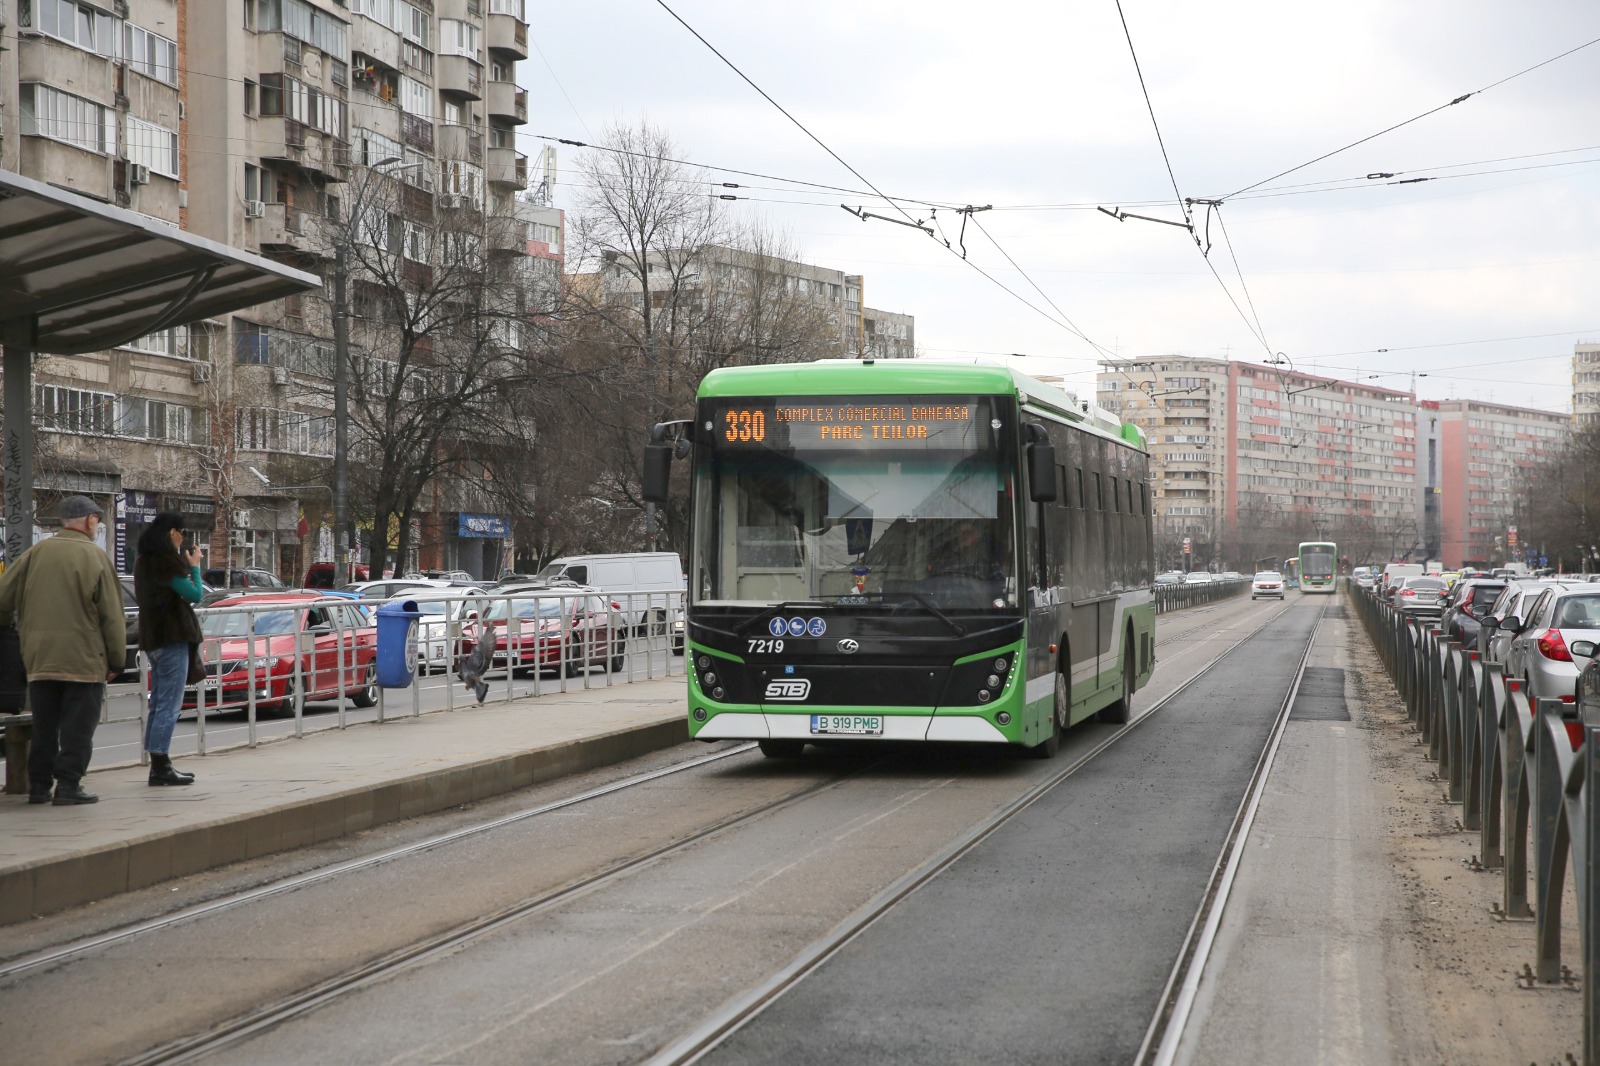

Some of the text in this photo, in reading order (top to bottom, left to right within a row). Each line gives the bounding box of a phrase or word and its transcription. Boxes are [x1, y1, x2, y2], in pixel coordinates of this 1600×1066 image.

[776, 407, 833, 422] COMPLEX
[838, 407, 907, 421] COMERCIAL
[725, 410, 765, 442] 330
[820, 425, 928, 440] PARC TEILOR
[748, 640, 784, 653] 7219
[765, 682, 807, 697] STB
[820, 717, 828, 728] B
[832, 717, 852, 729] 919
[853, 717, 879, 729] PMB
